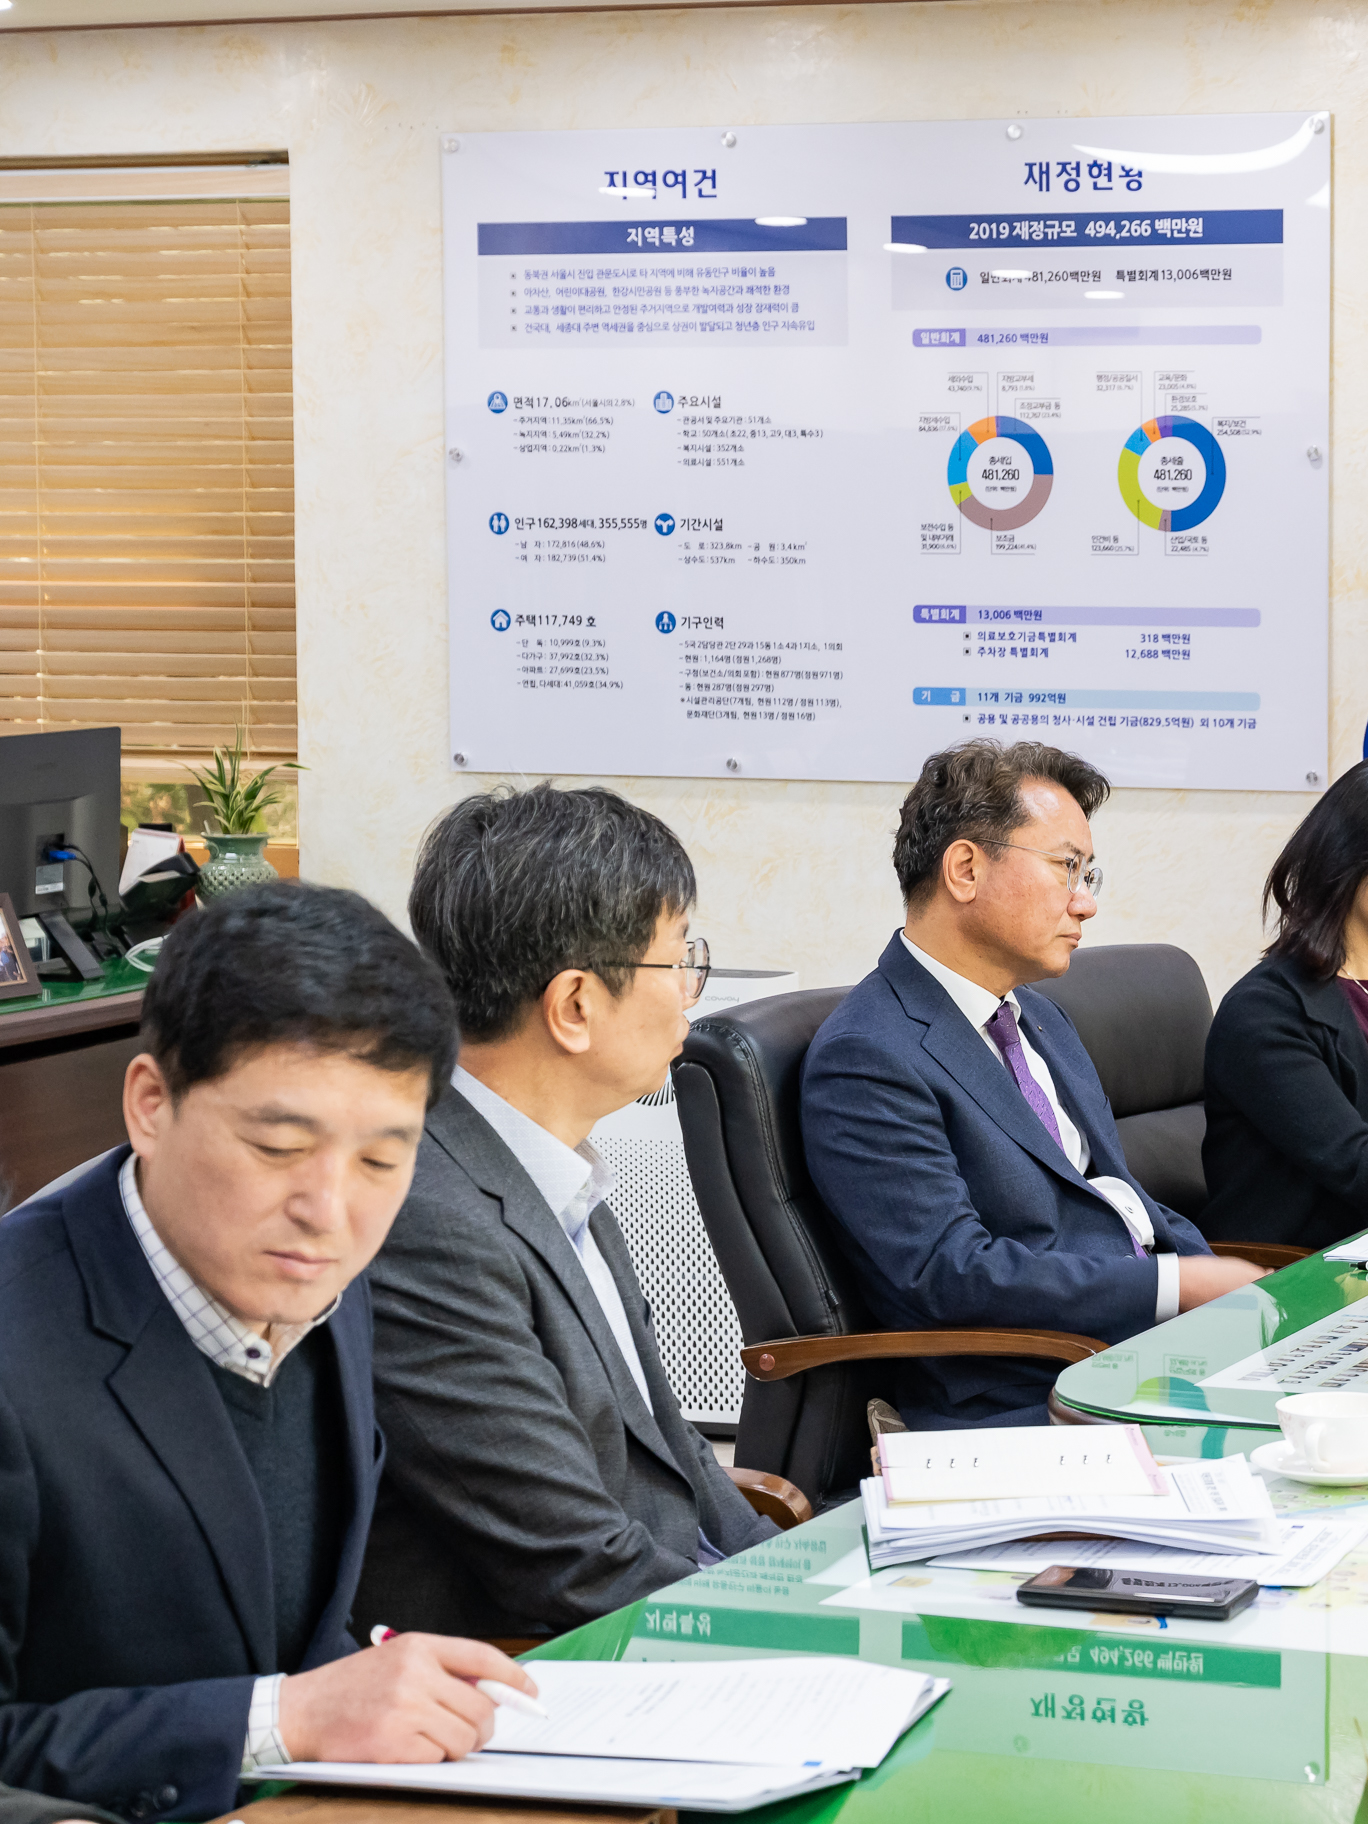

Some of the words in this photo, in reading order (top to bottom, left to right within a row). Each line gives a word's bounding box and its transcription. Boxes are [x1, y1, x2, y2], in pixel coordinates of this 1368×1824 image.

[604, 168, 718, 199] 지역여건
[969, 223, 1009, 240] 2019
[1013, 221, 1077, 240] 재정규모
[1085, 220, 1151, 240] 494,266
[1155, 218, 1204, 239] 백만원
[626, 226, 695, 247] 지역특성
[1116, 269, 1159, 282] 특별회계
[1162, 268, 1232, 282] 13,006백만원
[977, 333, 1017, 345] 481,260
[1020, 332, 1049, 344] 백만원
[677, 395, 721, 409] 주요시설
[981, 469, 1020, 481] 481,260
[1153, 469, 1193, 481] 481,260
[680, 518, 723, 531] 기간시설
[978, 610, 1012, 621] 13,006
[1014, 609, 1043, 621] 백만원
[681, 616, 724, 629] 기구인력
[1140, 633, 1159, 644] 318
[1161, 633, 1191, 645] 백만원
[977, 647, 1007, 658] 주차장
[1009, 647, 1049, 658] 특별회계
[1125, 649, 1159, 661] 12,688
[1161, 649, 1191, 661] 백만원
[978, 692, 999, 703] 11개
[1004, 692, 1023, 703] 기금
[1028, 692, 1067, 704] 992억원
[977, 713, 996, 725] 공용
[999, 713, 1009, 725] 및
[1011, 714, 1050, 726] 공공용의
[1098, 715, 1117, 727] 건립
[1200, 717, 1210, 728] 외
[1213, 717, 1235, 729] 10개
[1237, 718, 1257, 729] 기금
